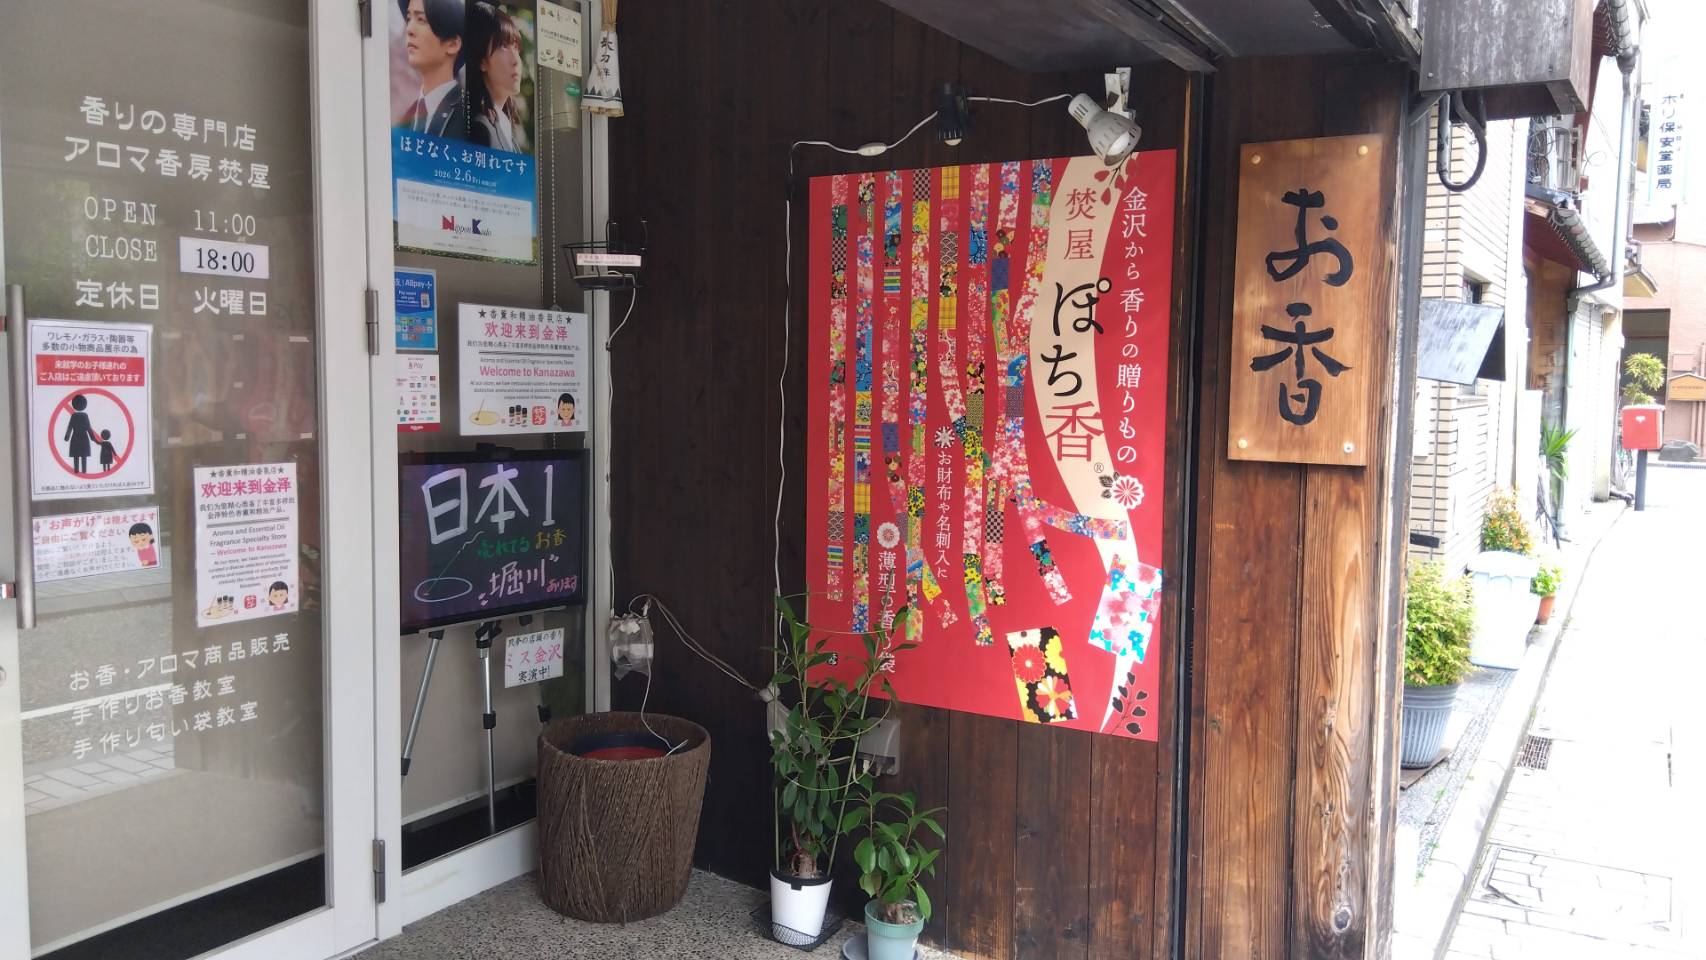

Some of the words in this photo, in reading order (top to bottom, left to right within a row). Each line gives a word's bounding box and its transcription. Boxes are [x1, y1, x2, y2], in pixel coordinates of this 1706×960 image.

[80, 95, 256, 151] 香りの専門店
[64, 136, 271, 189] アロマ香房焚屋
[400, 135, 527, 176] ほどなく、お別れです
[84, 196, 158, 226] OPEN
[194, 209, 256, 237] 11:00
[1063, 187, 1098, 261] 焚屋
[85, 234, 157, 262] CLOSE
[196, 247, 255, 273] 18:00
[75, 279, 160, 310] 定休日
[193, 286, 267, 316] 火曜日
[1249, 188, 1354, 426] お香
[485, 321, 568, 341] 欢迎来到金泽
[1116, 185, 1149, 464] 金沢から香りの贈りもの
[42, 341, 138, 354] 多数の小物商品展示の為
[480, 366, 520, 377] Welcome
[523, 368, 532, 376] to
[534, 368, 575, 378] Kanazawa
[1040, 277, 1113, 462] ぽち香
[201, 476, 292, 499] 欢迎来到金泽
[248, 524, 276, 534] Essential
[934, 451, 953, 579] お財布や名刺入に
[210, 538, 241, 548] Fragrance
[242, 534, 270, 545] Specialty
[270, 533, 287, 541] Store
[217, 547, 247, 557] Welcome
[70, 632, 290, 691] お香・アロマ商品販売
[506, 643, 563, 670] ミス金沢
[71, 675, 236, 726] 手作りお香教室
[72, 701, 258, 760] 手作り匂い袋教室
